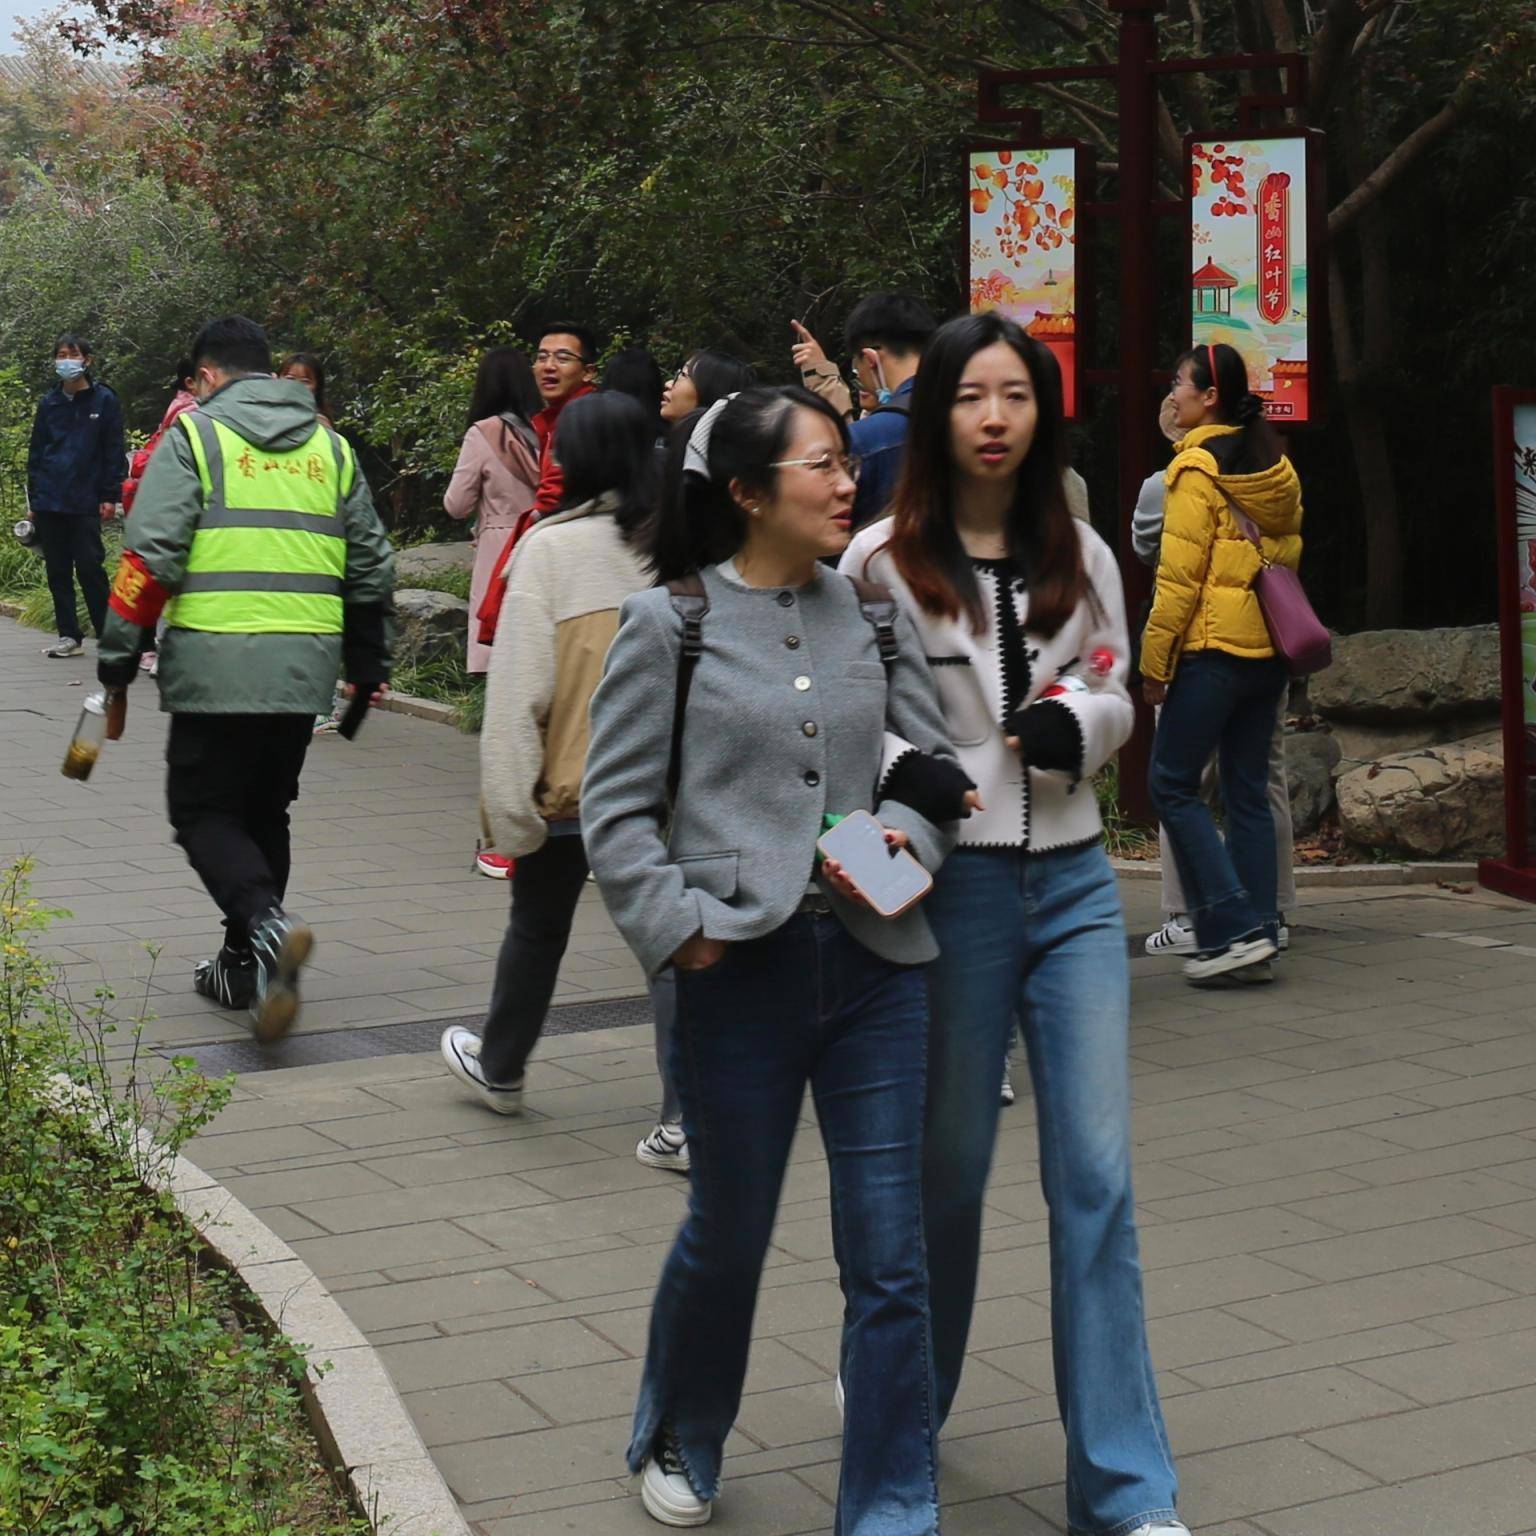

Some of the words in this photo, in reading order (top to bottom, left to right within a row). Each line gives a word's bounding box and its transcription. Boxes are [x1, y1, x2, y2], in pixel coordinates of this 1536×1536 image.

[1264, 192, 1283, 311] 香山红叶节
